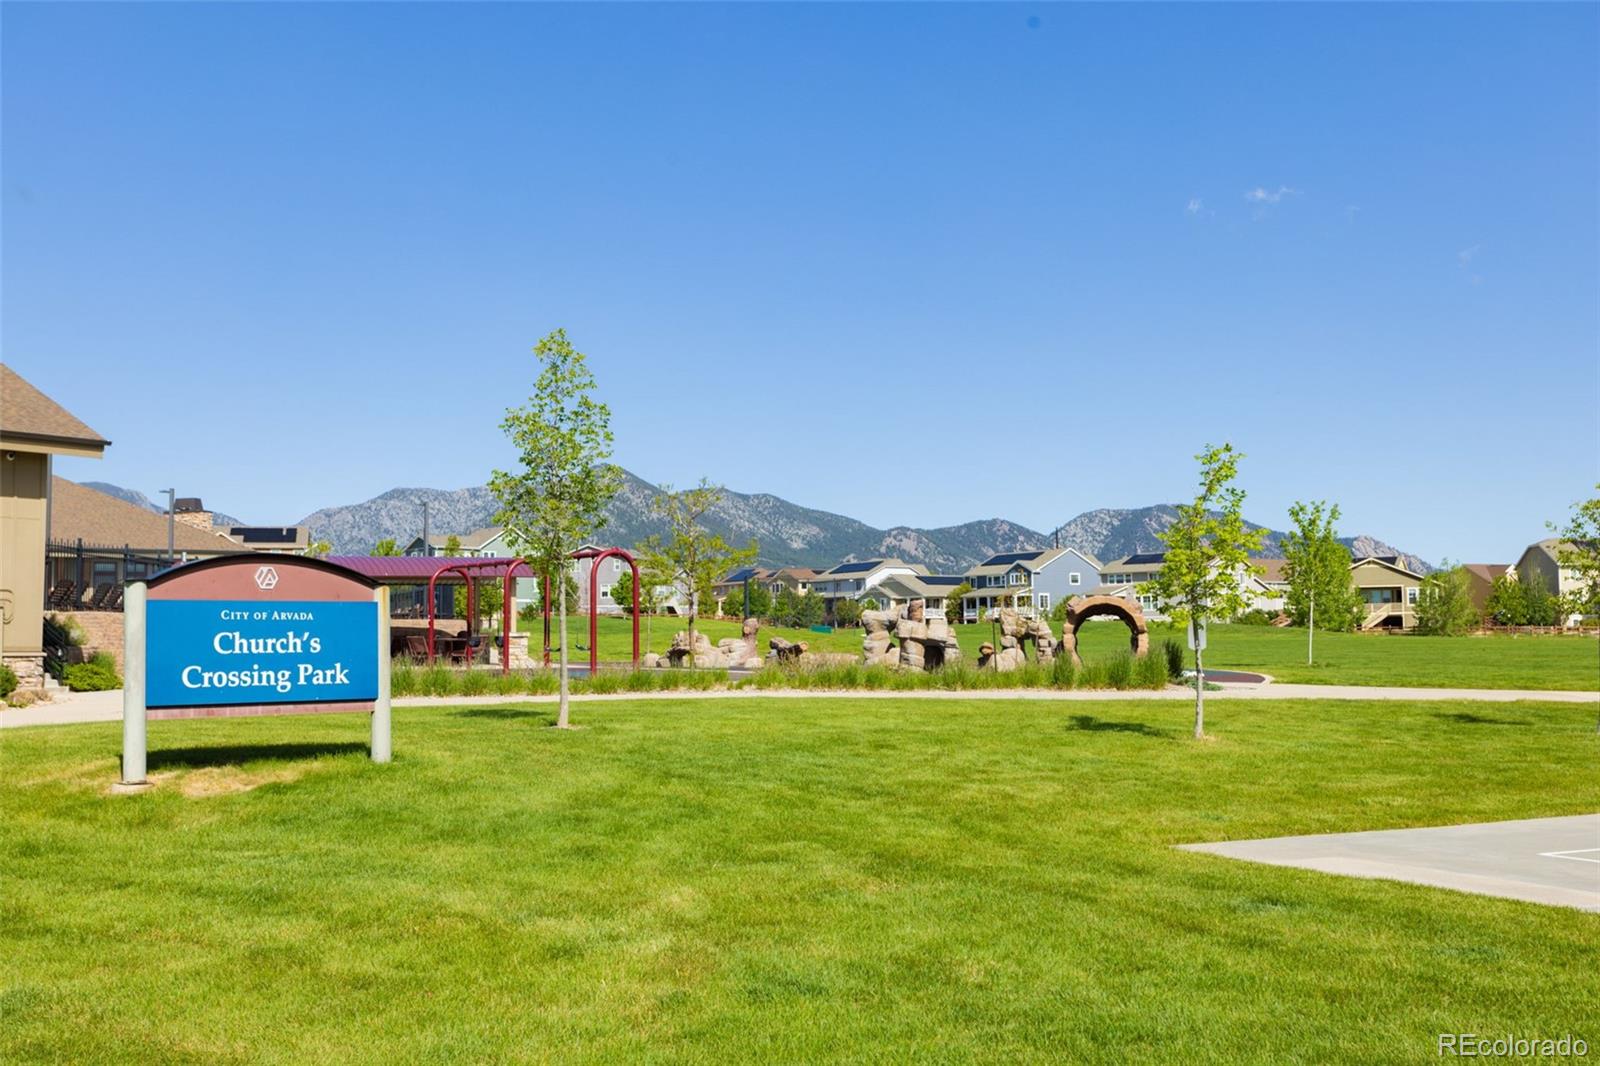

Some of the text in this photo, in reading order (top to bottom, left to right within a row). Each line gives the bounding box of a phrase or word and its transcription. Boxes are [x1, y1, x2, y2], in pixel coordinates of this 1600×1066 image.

[213, 631, 322, 655] Church's
[181, 662, 350, 693] Crossing Park
